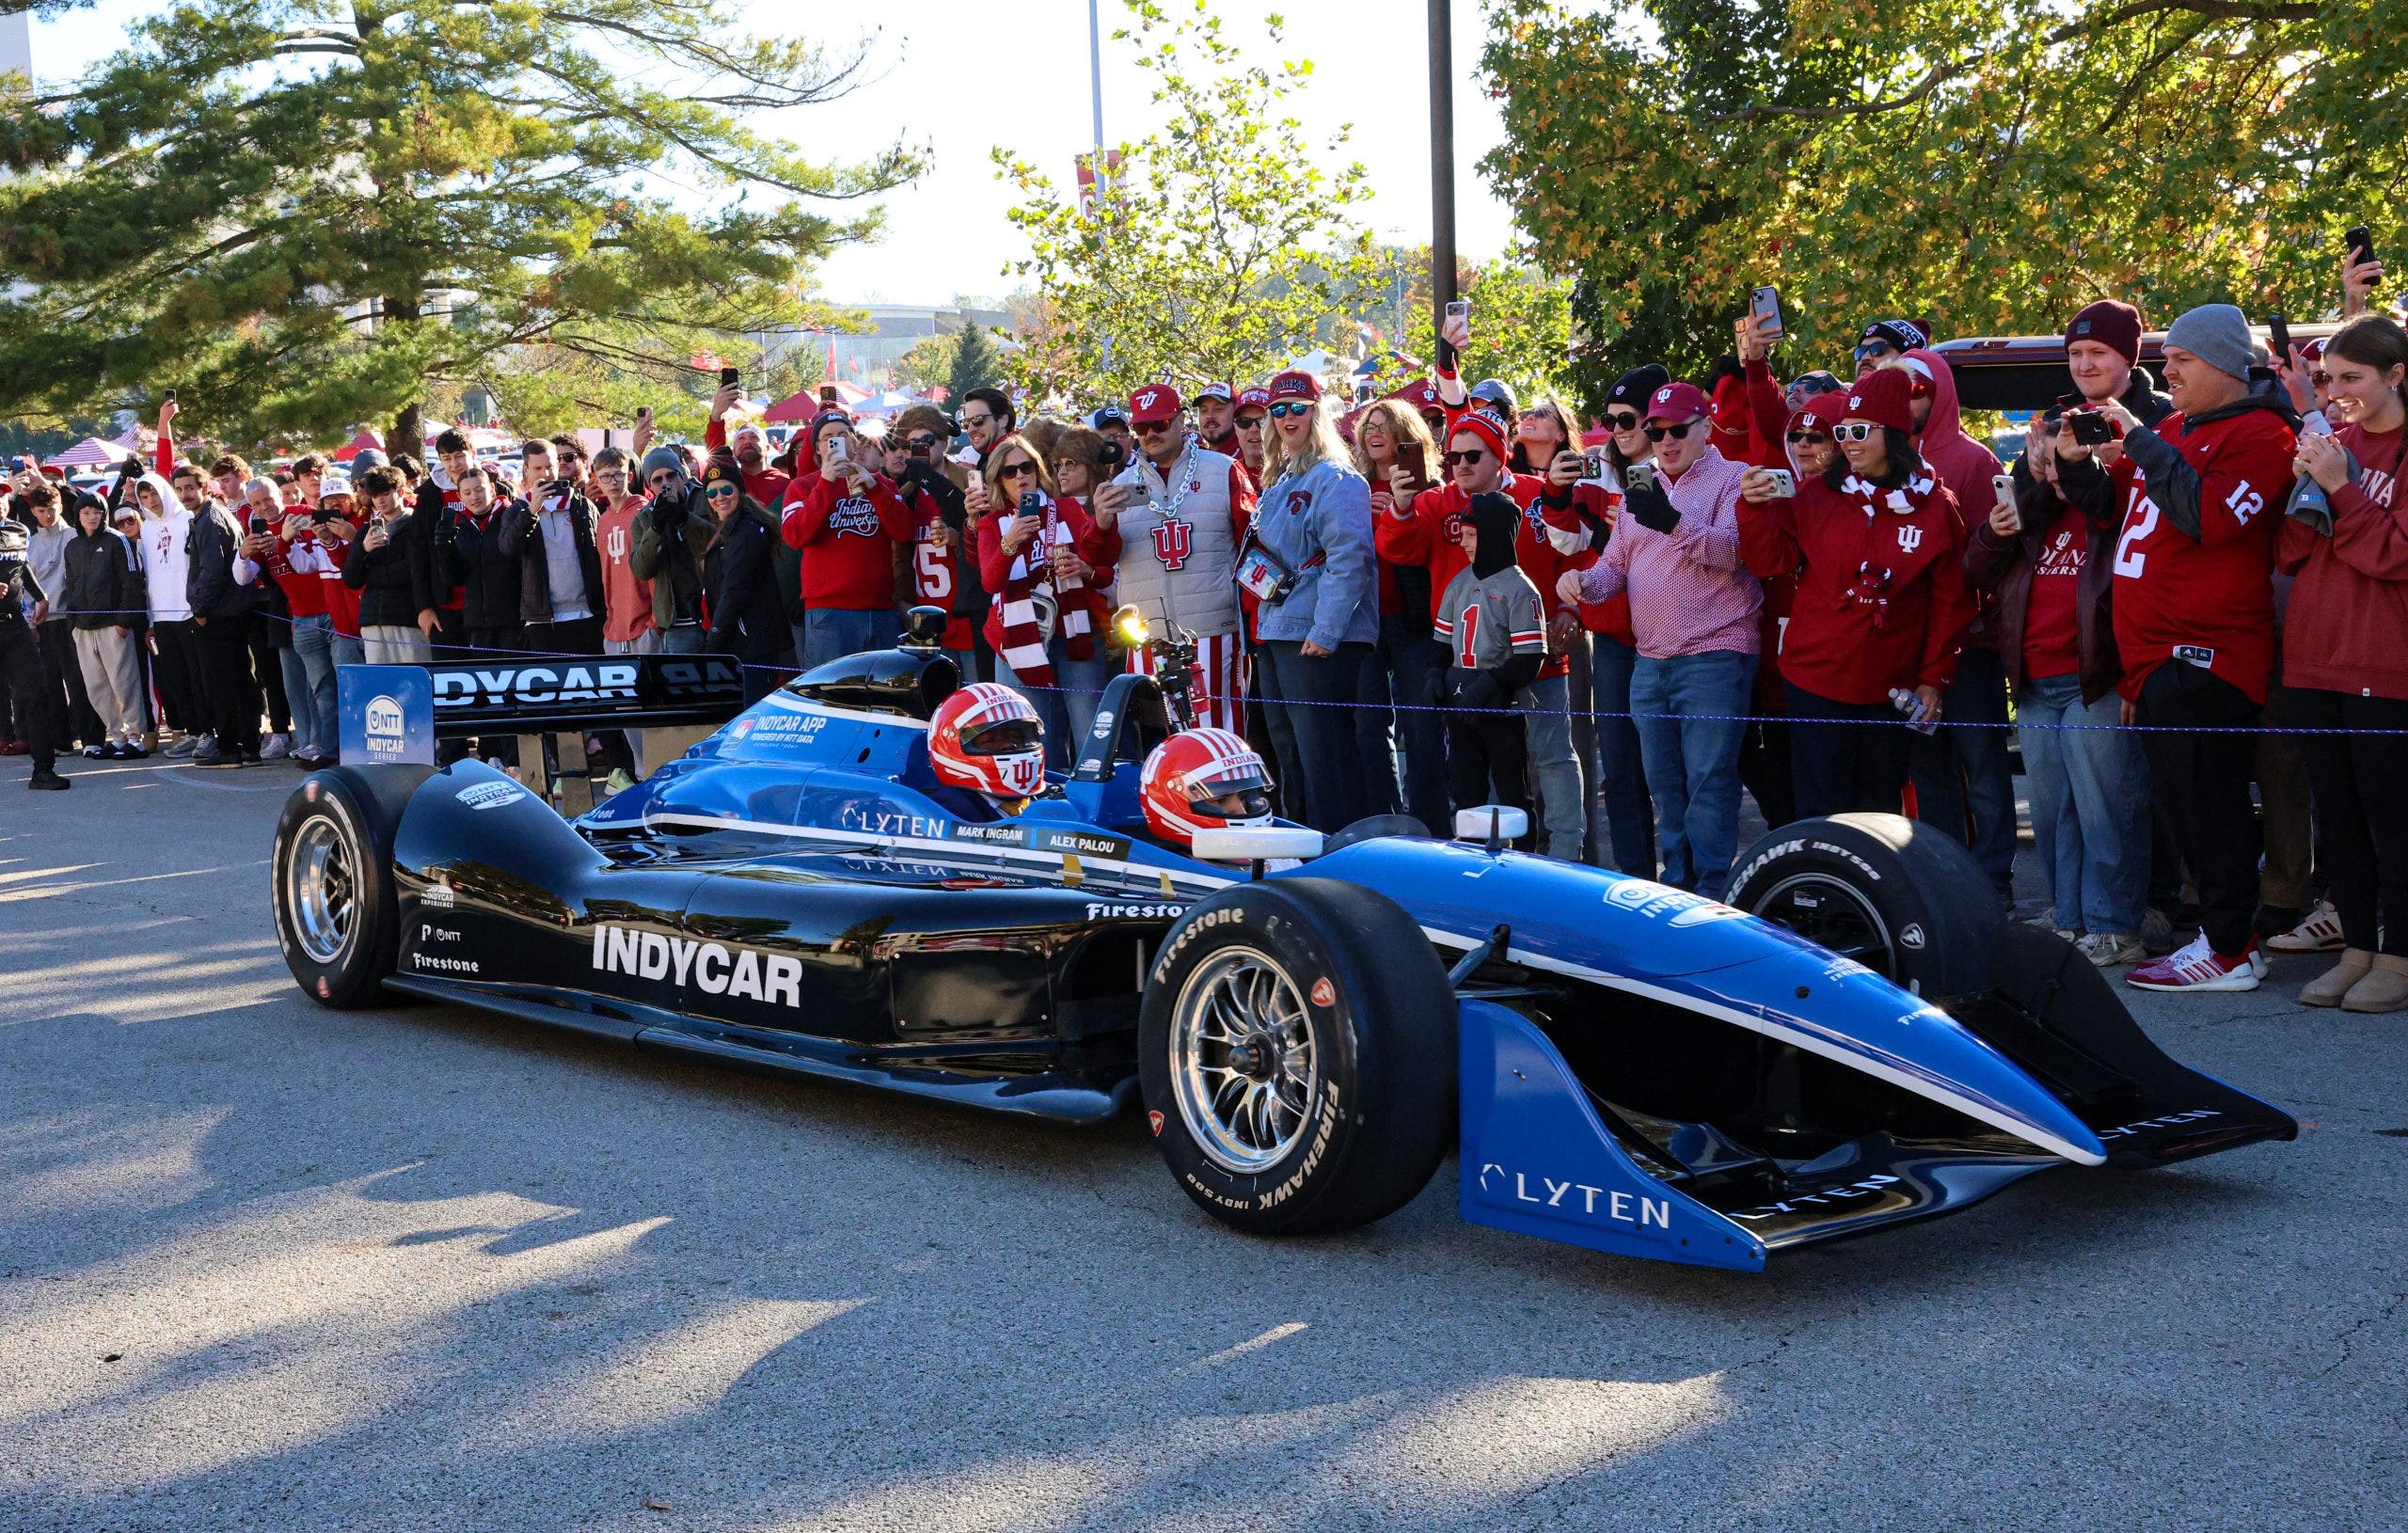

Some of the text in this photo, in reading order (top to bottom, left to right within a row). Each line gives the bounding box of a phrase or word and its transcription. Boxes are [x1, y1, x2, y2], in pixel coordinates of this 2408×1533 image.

[1656, 388, 1672, 403] IU
[1848, 396, 1862, 411] IU
[835, 497, 875, 516] Indian
[2225, 480, 2264, 526] 12
[1047, 511, 1057, 544] HOOSIERS
[606, 525, 626, 564] IU
[1150, 518, 1193, 571] IU
[1897, 524, 1924, 553] IU
[2055, 531, 2072, 550] IU
[2036, 566, 2079, 576] SIERS
[1460, 604, 1480, 669] 1
[434, 665, 639, 705] DYCAR
[381, 714, 400, 728] NTT
[754, 716, 828, 733] INDYCAR APP
[367, 737, 404, 752] INDYCAR
[797, 735, 815, 744] DATA
[374, 752, 397, 761] SERIES
[1012, 759, 1034, 789] IU
[861, 812, 945, 838] LYTEN
[957, 825, 1023, 841] MARK INGRAM
[1050, 834, 1115, 854] ALEX PALOU
[420, 899, 453, 909] EXPERIENCE
[427, 893, 453, 902] INDYCAR
[1085, 903, 1191, 921] Firesto
[445, 931, 461, 941] NTT
[1155, 908, 1244, 985] Firestone
[413, 953, 479, 972] Firestone
[593, 925, 802, 1007] INDYCAR
[1258, 1079, 1339, 1210] FIREHAWK
[1516, 1172, 1669, 1229] LYTEN
